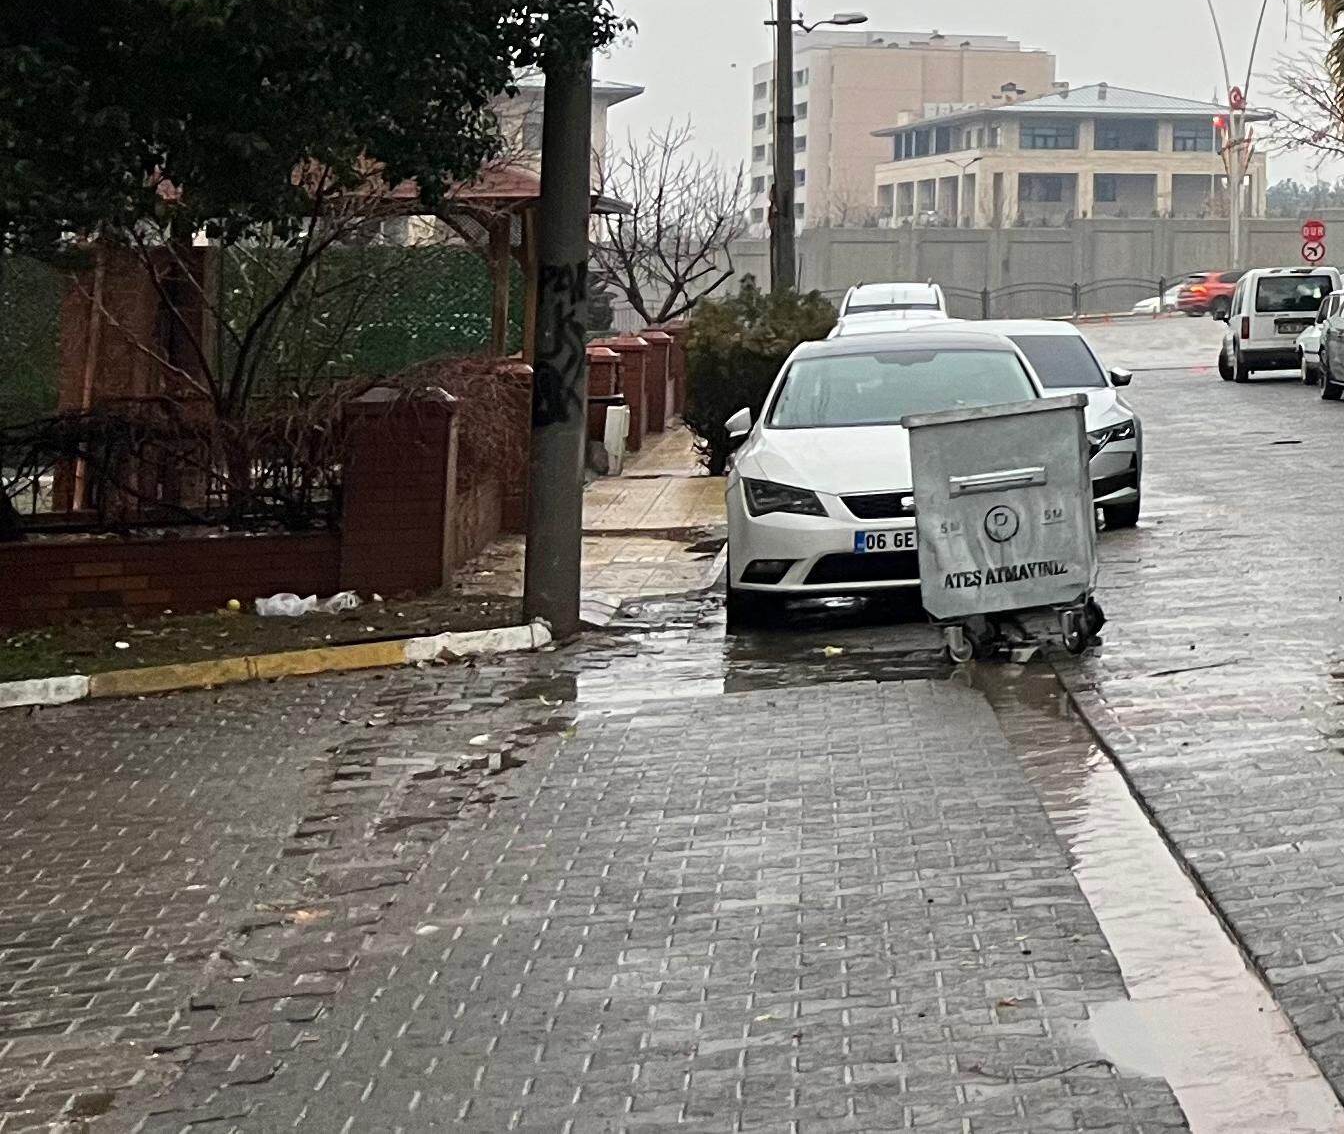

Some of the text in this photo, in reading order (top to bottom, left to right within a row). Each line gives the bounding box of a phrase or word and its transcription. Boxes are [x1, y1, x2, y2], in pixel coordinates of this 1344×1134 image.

[1303, 226, 1324, 236] DUR
[865, 531, 915, 550] 06 GE
